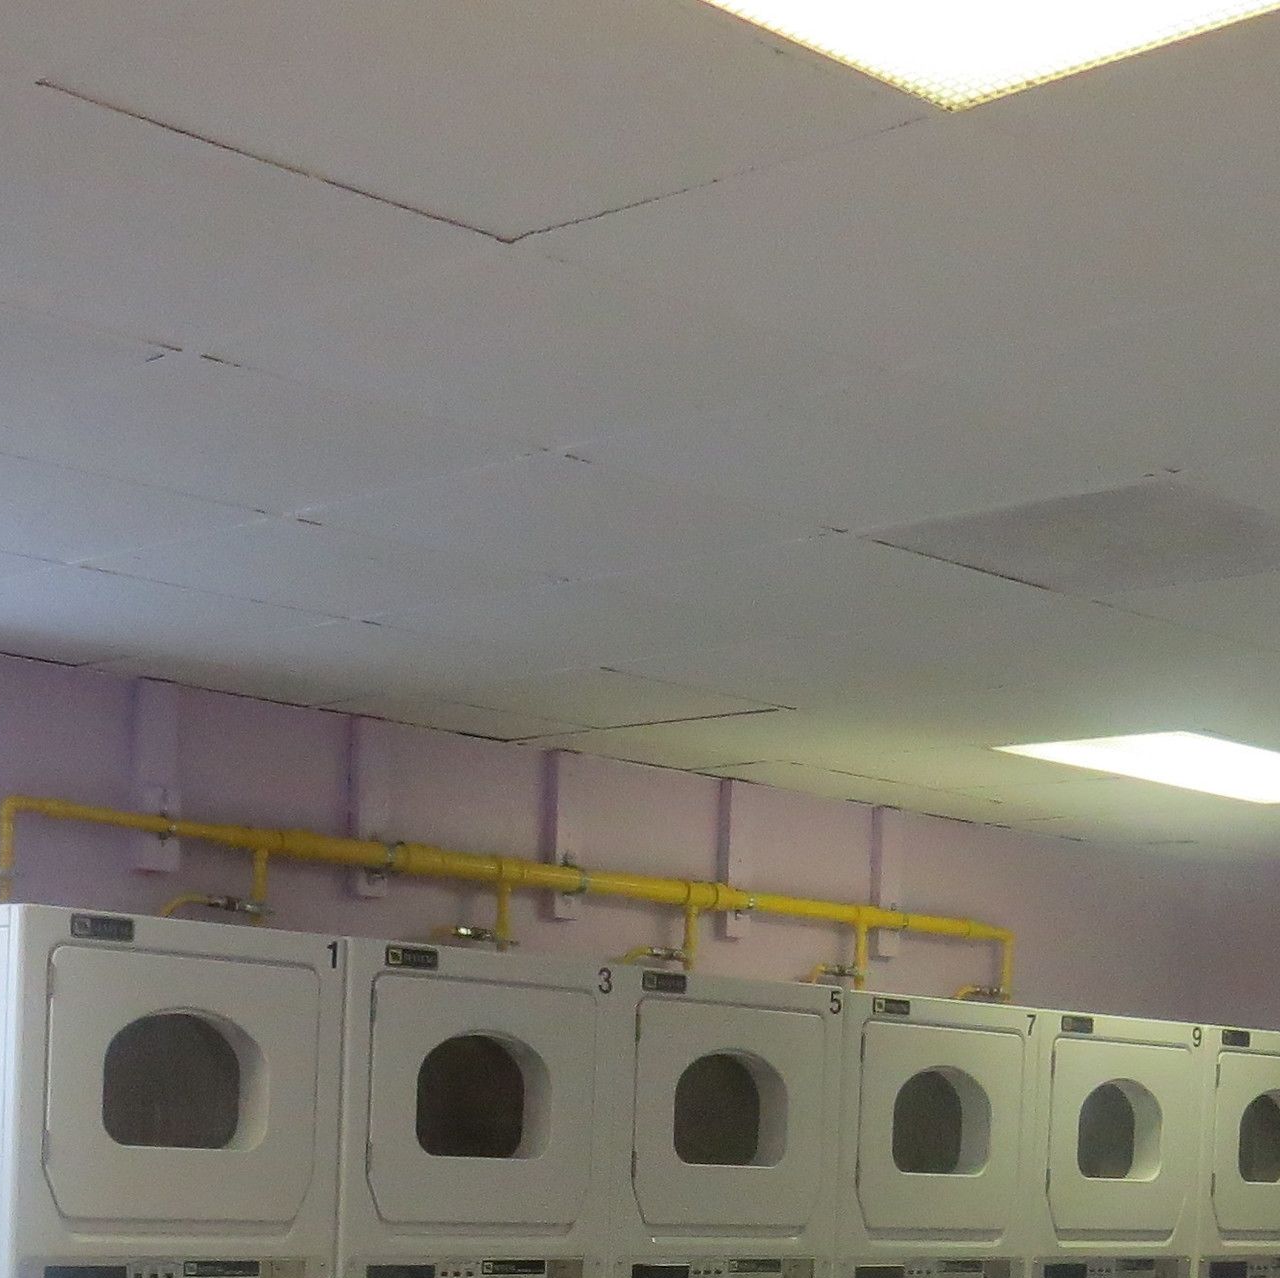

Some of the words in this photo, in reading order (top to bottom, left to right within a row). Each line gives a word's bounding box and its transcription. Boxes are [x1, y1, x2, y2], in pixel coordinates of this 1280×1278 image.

[327, 941, 338, 969] 1
[598, 967, 613, 995] 3
[828, 990, 842, 1015] 5
[1026, 1015, 1038, 1036] 7
[1191, 1026, 1202, 1048] 9
